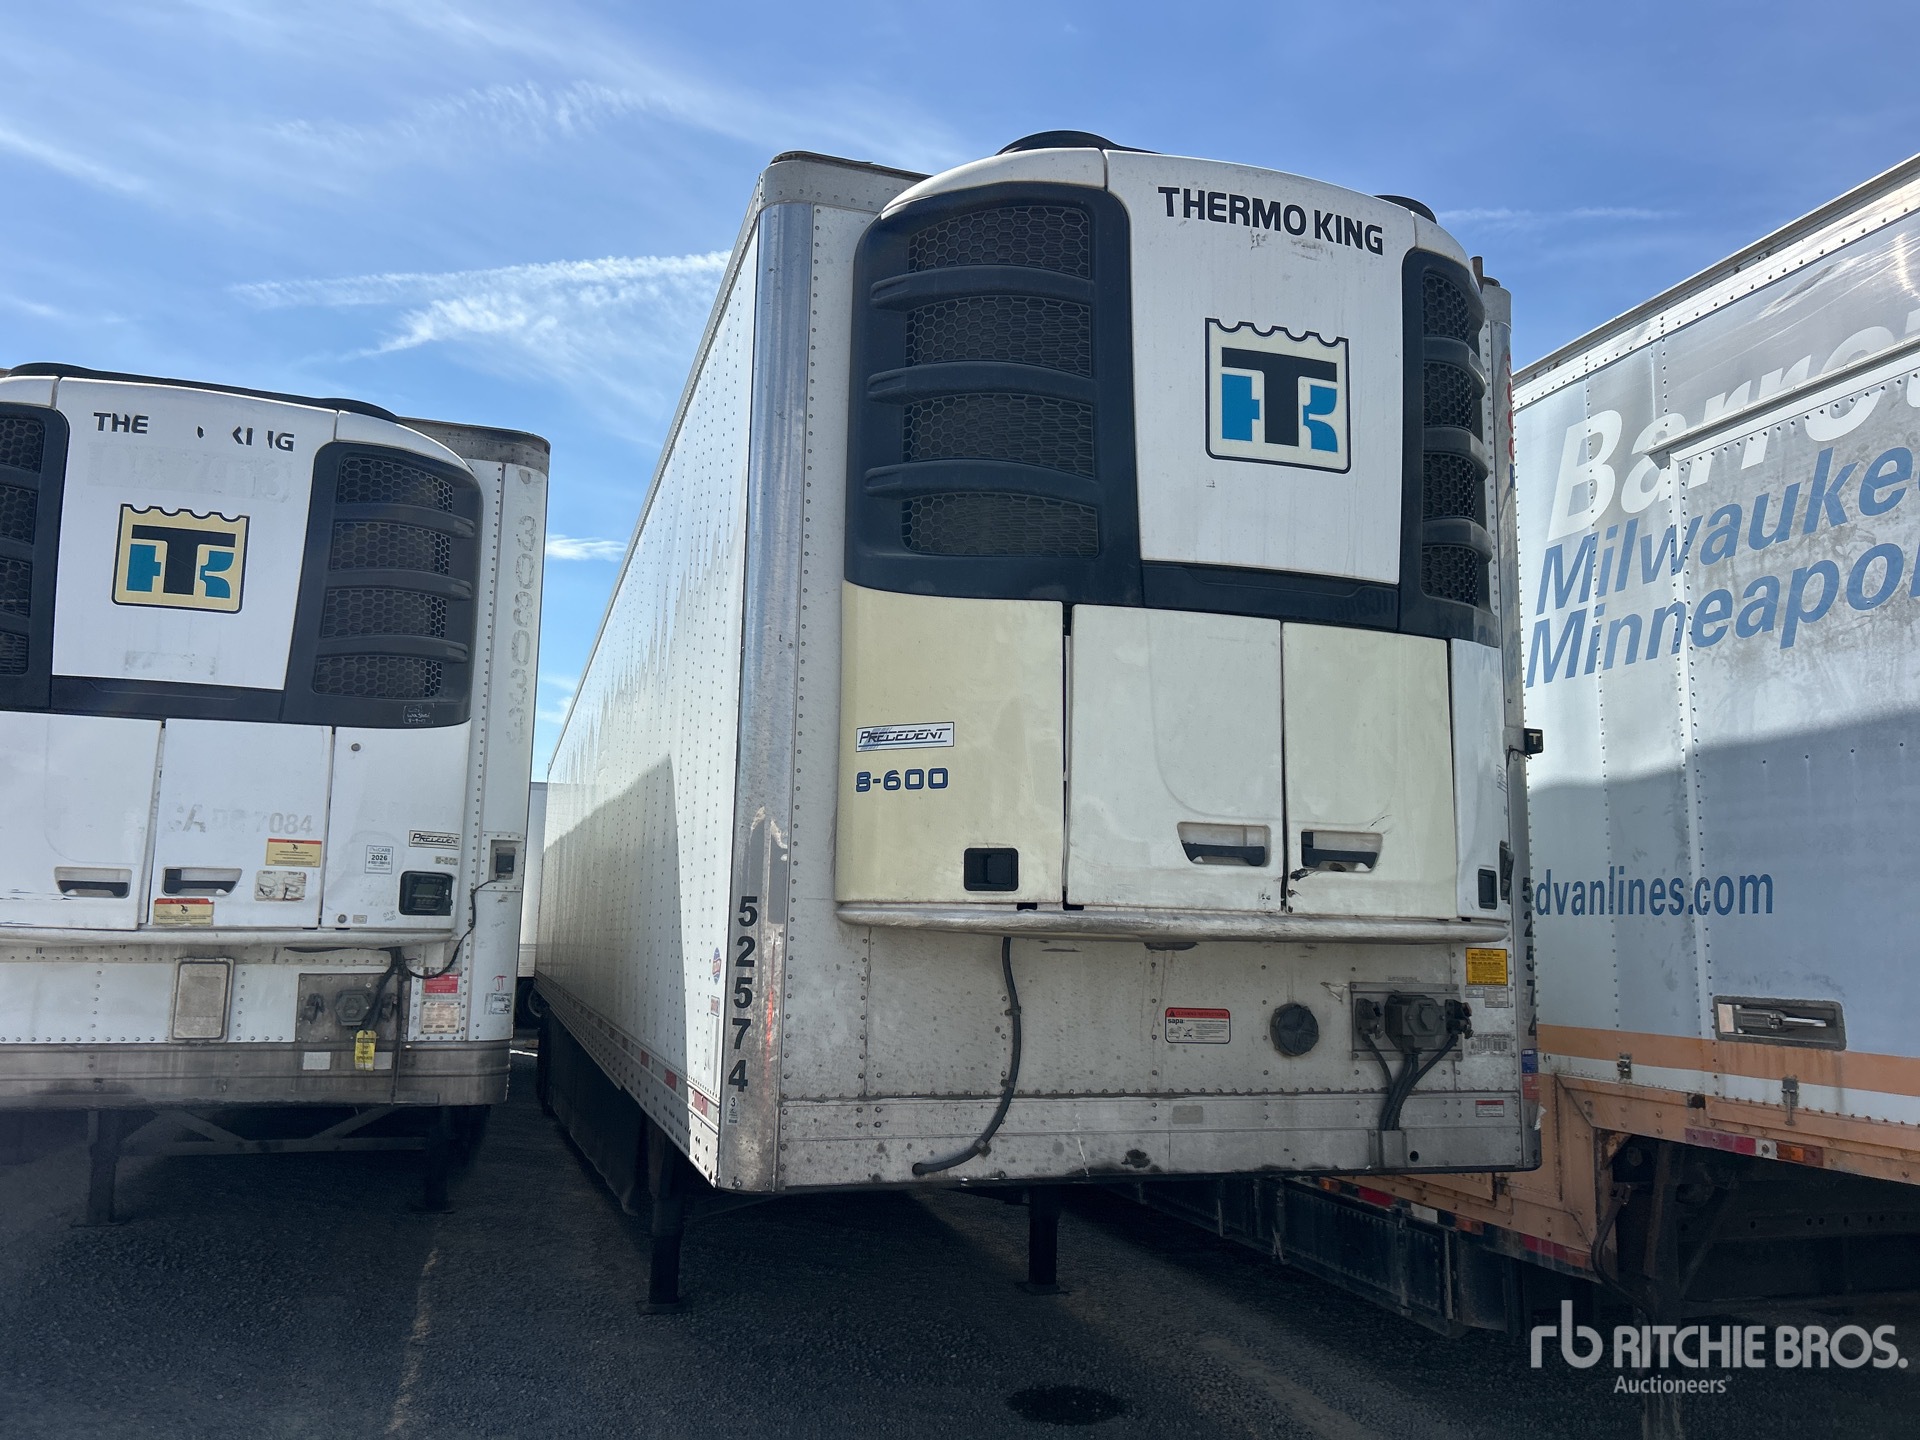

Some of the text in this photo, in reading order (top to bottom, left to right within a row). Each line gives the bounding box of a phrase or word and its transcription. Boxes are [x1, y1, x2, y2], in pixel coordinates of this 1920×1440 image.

[1158, 187, 1383, 255] THERMO KING
[1536, 445, 1920, 616] Milwauke
[1526, 543, 1920, 688] Minneapo
[859, 728, 951, 744] PRECEDENT
[1535, 866, 1774, 916] dvanlines.com
[728, 896, 758, 1093] 52574
